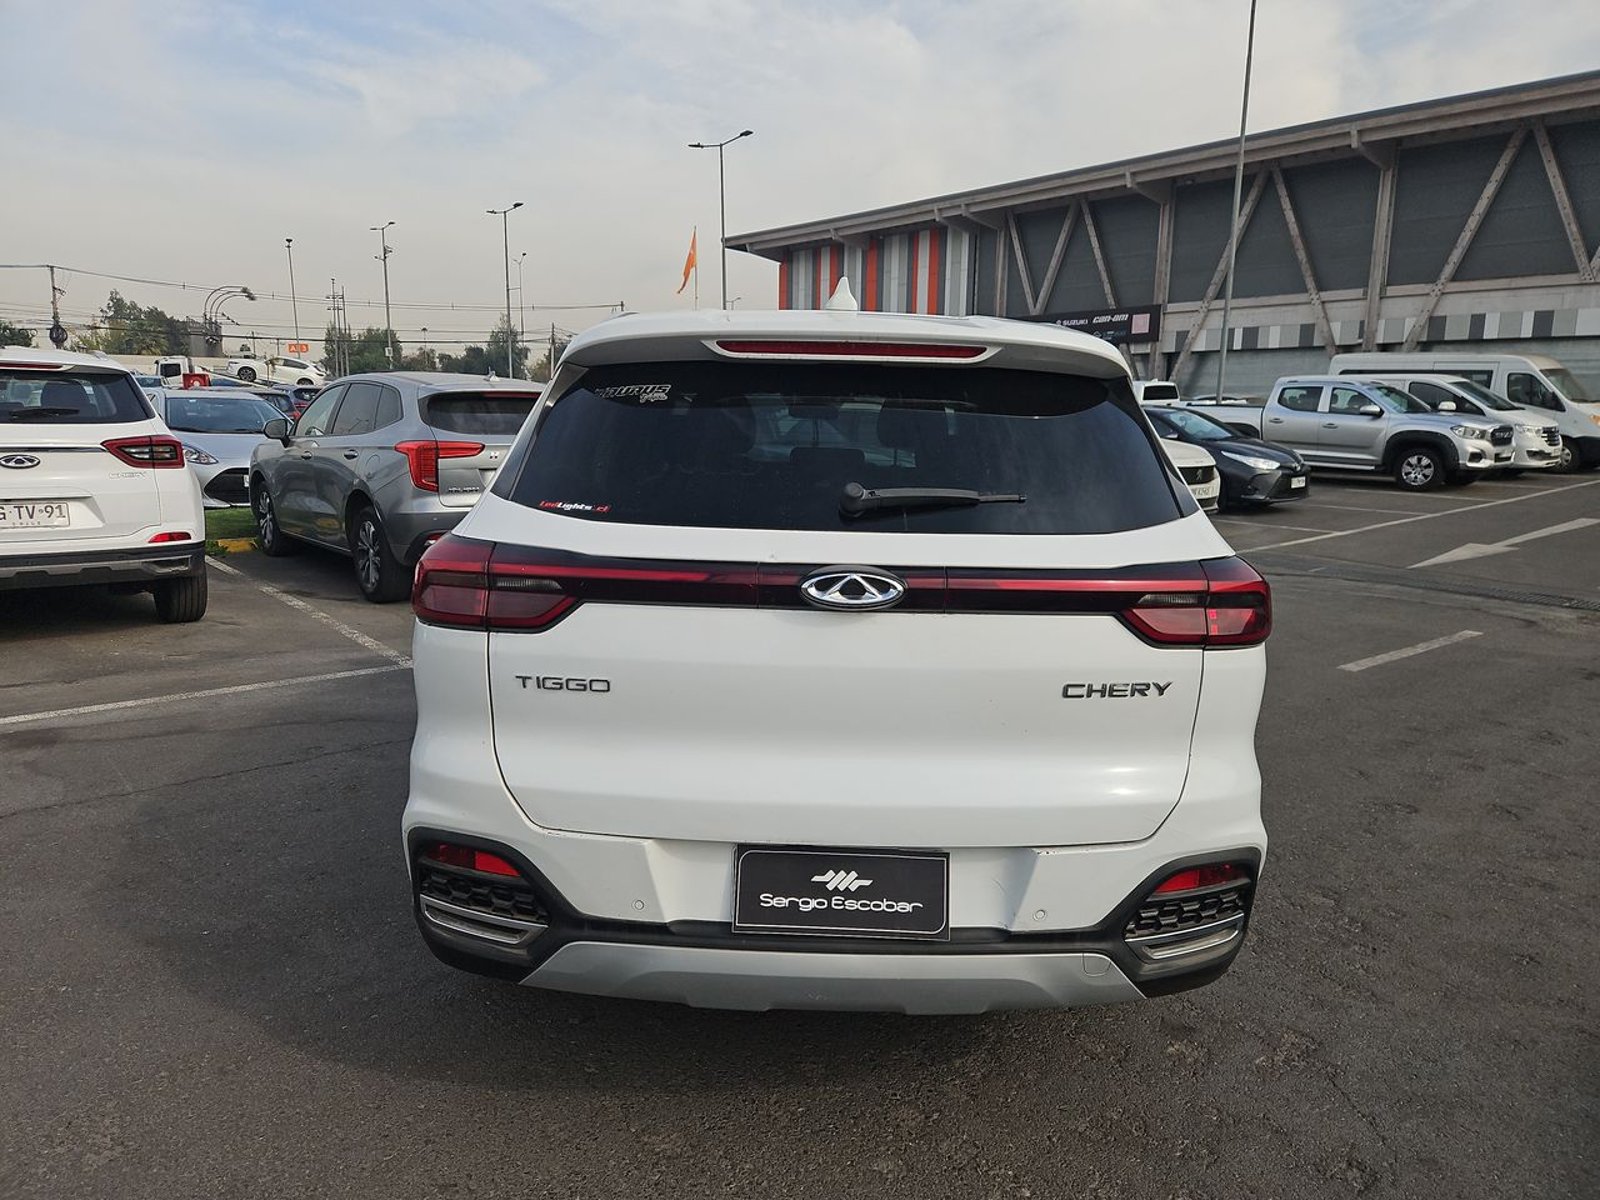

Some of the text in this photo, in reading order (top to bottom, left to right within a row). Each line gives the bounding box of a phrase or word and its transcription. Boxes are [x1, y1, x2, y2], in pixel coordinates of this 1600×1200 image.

[515, 675, 611, 693] TIGGO
[1062, 681, 1174, 699] CHERY
[759, 893, 924, 913] Sergio Escobar
